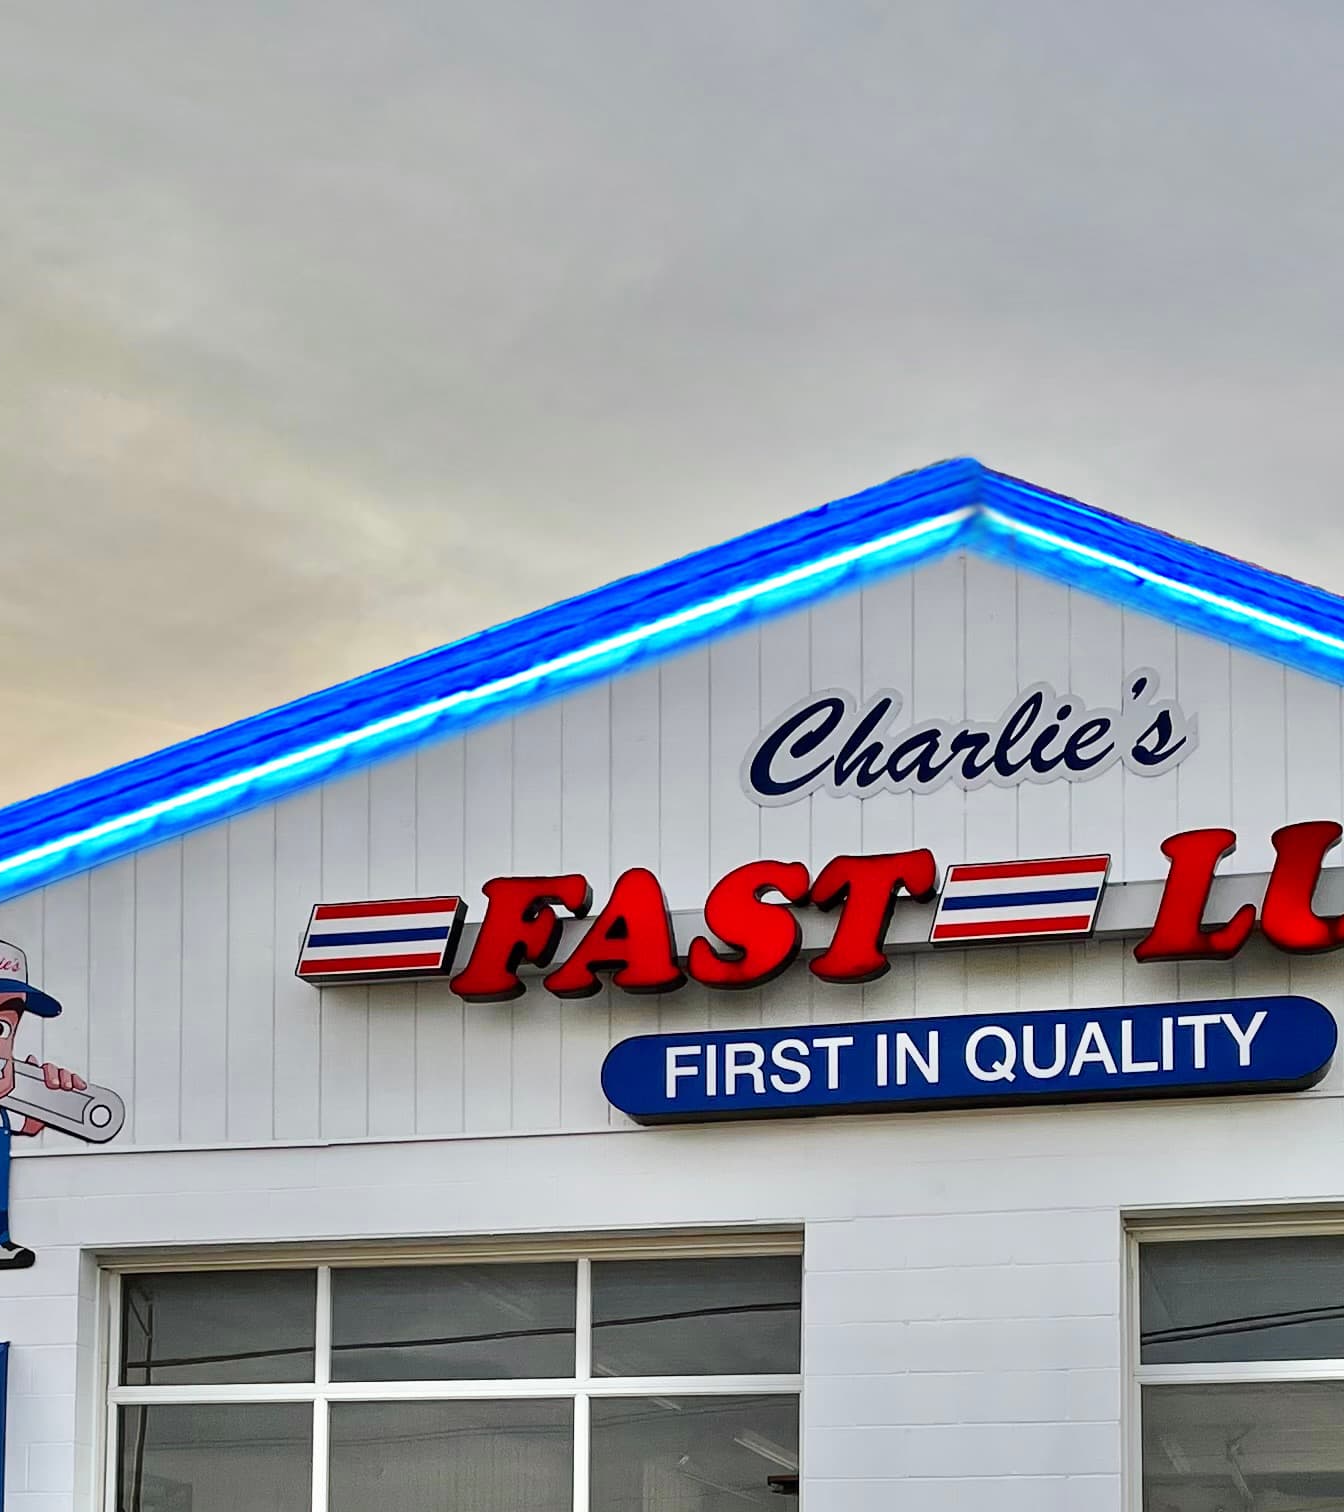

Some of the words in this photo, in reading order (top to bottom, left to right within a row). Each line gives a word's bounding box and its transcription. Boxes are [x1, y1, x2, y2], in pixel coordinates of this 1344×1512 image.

[749, 676, 1187, 797] Charlie's
[449, 848, 937, 999] FAST
[665, 1035, 854, 1098] FIRST
[876, 1030, 939, 1087] IN
[964, 1011, 1269, 1083] QUALITY
